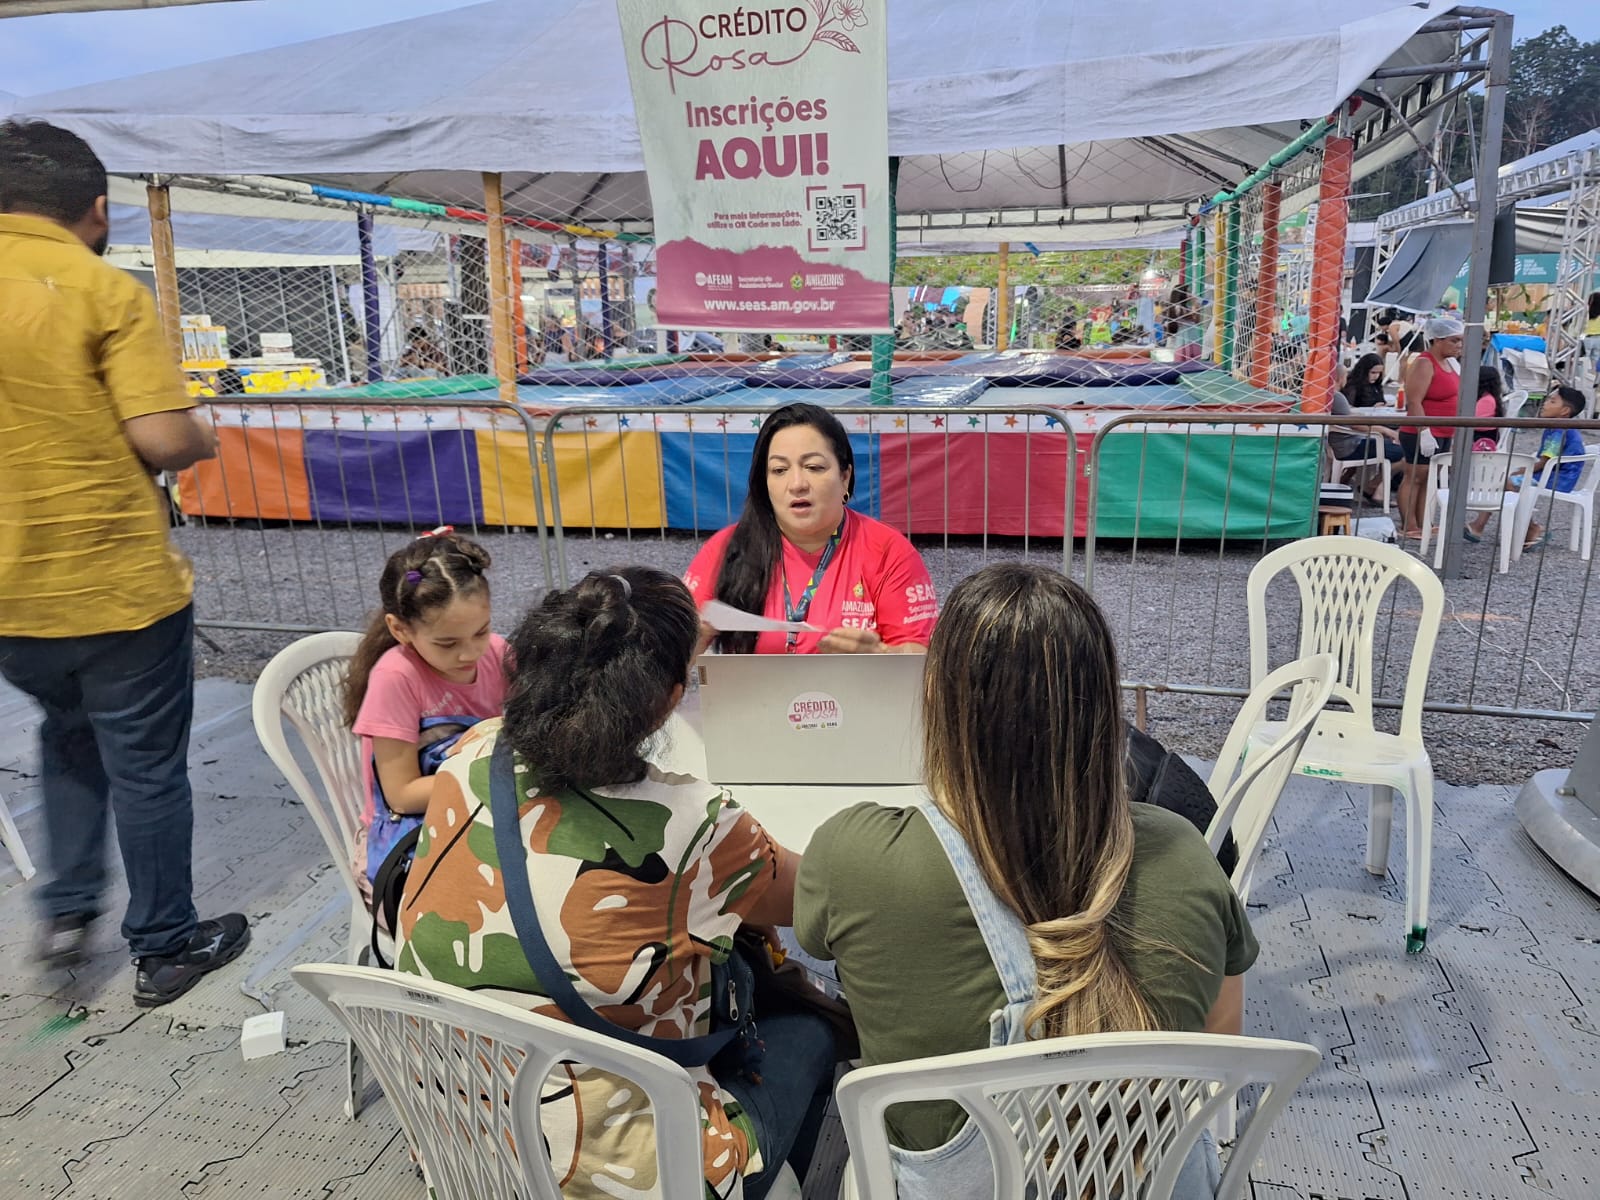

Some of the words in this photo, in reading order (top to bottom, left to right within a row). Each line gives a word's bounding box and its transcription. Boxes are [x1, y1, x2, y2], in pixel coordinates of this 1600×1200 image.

[700, 7, 807, 39] CRÉDITO
[641, 15, 775, 95] Rosa
[686, 96, 828, 132] Inscrições
[695, 133, 830, 181] AQUI!
[713, 212, 729, 220] Para
[730, 211, 747, 220] mais
[748, 220, 769, 228] Code
[707, 274, 733, 285] AFEAM
[704, 298, 835, 314] www.seas.am.gov.br
[794, 699, 835, 713] CRÉDITO
